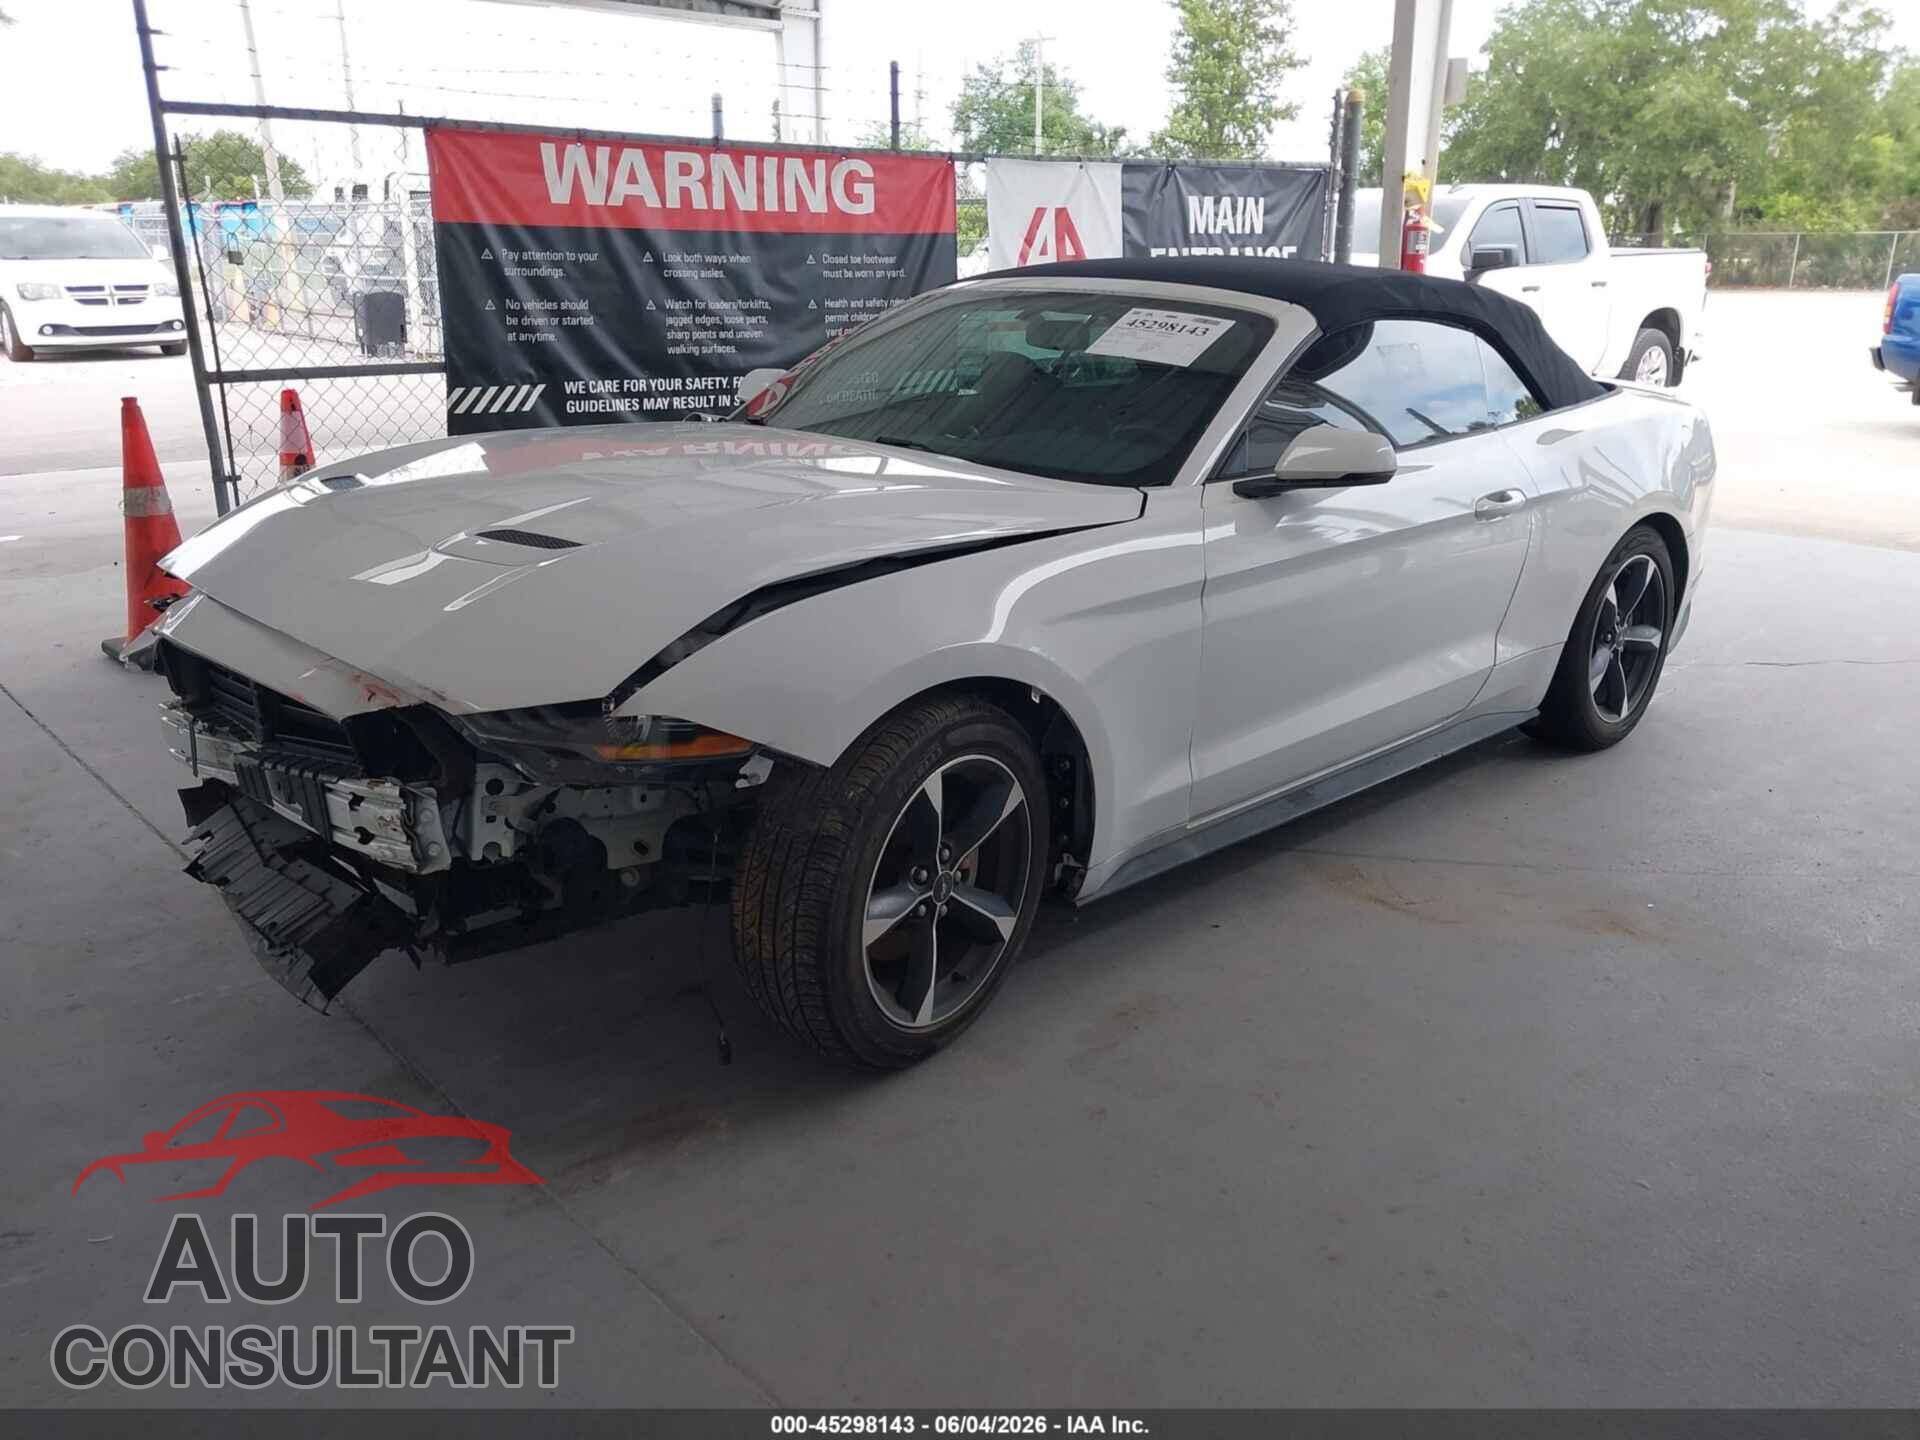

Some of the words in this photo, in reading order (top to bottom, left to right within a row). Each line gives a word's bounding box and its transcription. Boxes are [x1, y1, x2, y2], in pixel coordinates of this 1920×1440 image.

[540, 142, 876, 215] WARNING
[1188, 196, 1265, 234] MAIN
[502, 249, 519, 263] Pay
[522, 250, 562, 262] attention
[565, 251, 574, 262] to
[577, 254, 599, 265] your
[663, 252, 682, 263] Look
[684, 252, 702, 263] both
[704, 254, 728, 264] ways
[729, 253, 751, 263] when
[822, 254, 848, 265] Closed
[863, 254, 896, 265] footwear
[504, 265, 567, 279] surroundings.
[664, 269, 698, 280] crossing
[700, 268, 726, 279] aisles.
[823, 269, 843, 279] must
[844, 268, 853, 278] be
[855, 270, 875, 278] worn
[877, 270, 886, 279] on
[888, 268, 907, 281] yard.
[505, 299, 520, 311] No
[523, 298, 558, 311] vehicles
[561, 299, 589, 311] should
[664, 299, 693, 310] Watch
[695, 299, 707, 310] for
[825, 298, 849, 309] Health
[851, 298, 864, 308] and
[506, 315, 518, 326] be
[521, 315, 548, 326] driven
[550, 317, 559, 326] or
[562, 315, 594, 326] started
[665, 313, 693, 327] jagged
[695, 315, 723, 326] edges,
[724, 314, 744, 325] loose
[746, 315, 769, 326] parts,
[825, 313, 849, 324] permit
[508, 332, 517, 342] at
[519, 332, 559, 345] anytime.
[667, 330, 690, 340] sharp
[692, 330, 717, 341] points
[719, 329, 734, 339] and
[667, 345, 700, 357] walking
[701, 344, 738, 354] surfaces.
[565, 382, 586, 395] WE
[589, 380, 620, 394] CARE
[624, 380, 647, 393] FOR
[650, 379, 682, 392] YOUR
[685, 376, 731, 391] SAFETY.
[567, 399, 641, 414] GUIDELINES
[644, 398, 670, 411] MAY
[673, 395, 716, 410] RESULT
[718, 395, 732, 408] IN
